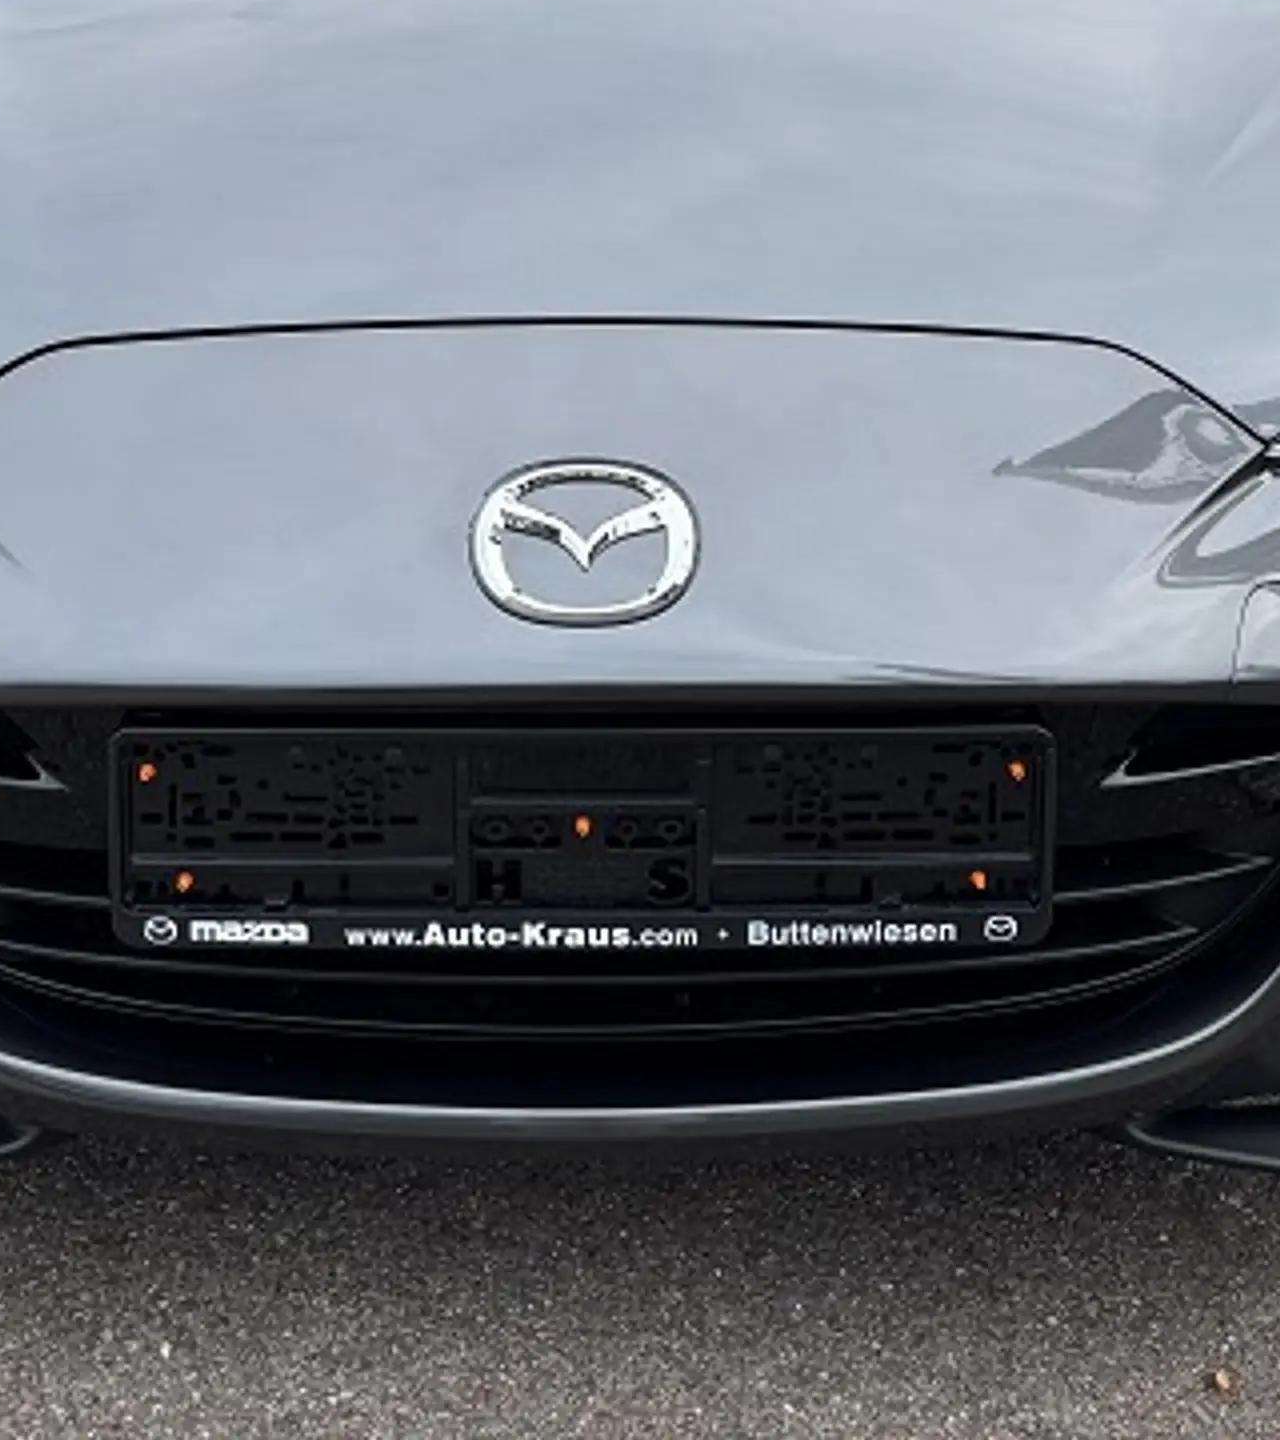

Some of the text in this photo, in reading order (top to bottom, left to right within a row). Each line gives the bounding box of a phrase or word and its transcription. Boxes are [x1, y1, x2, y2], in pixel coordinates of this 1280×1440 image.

[189, 919, 957, 947] mazda www.Auto-Kraus.com Buttenwiesen
